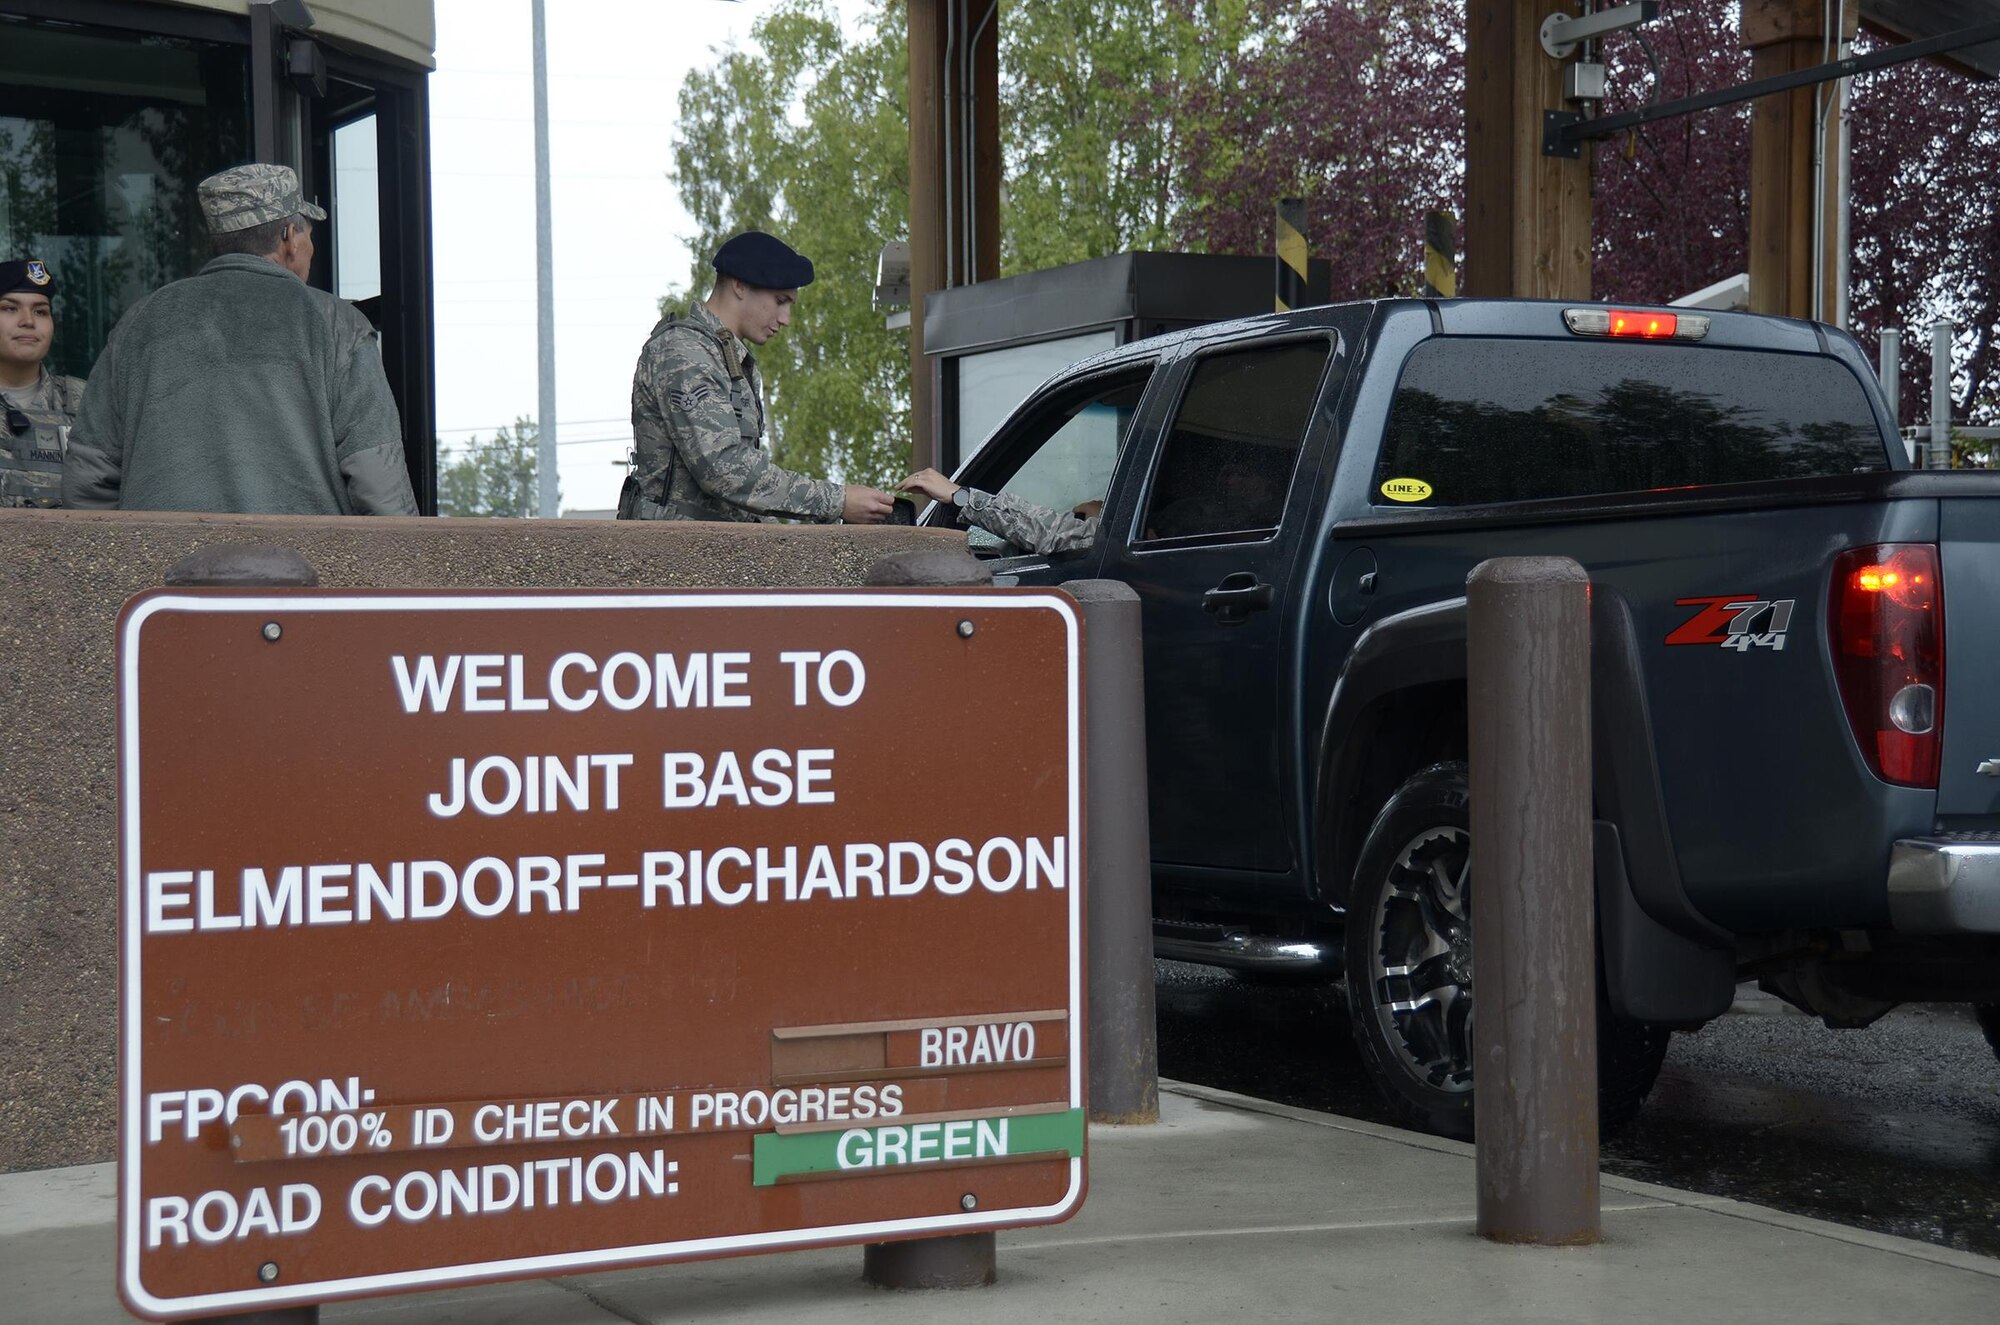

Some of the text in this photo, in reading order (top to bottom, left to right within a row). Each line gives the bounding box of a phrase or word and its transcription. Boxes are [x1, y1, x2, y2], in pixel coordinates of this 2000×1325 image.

[1664, 594, 1796, 646] Z71
[391, 649, 866, 714] WELCOME TO
[427, 748, 836, 818] JOINT BASE
[146, 835, 1066, 934] ELMENDORF-RICHARDSON
[920, 1021, 1035, 1068] BRAVO
[280, 1084, 904, 1156] 100% ID CHECK IN PROGRESS
[836, 1117, 1009, 1171] GREEN
[147, 1149, 679, 1249] ROAD CONDITION:
